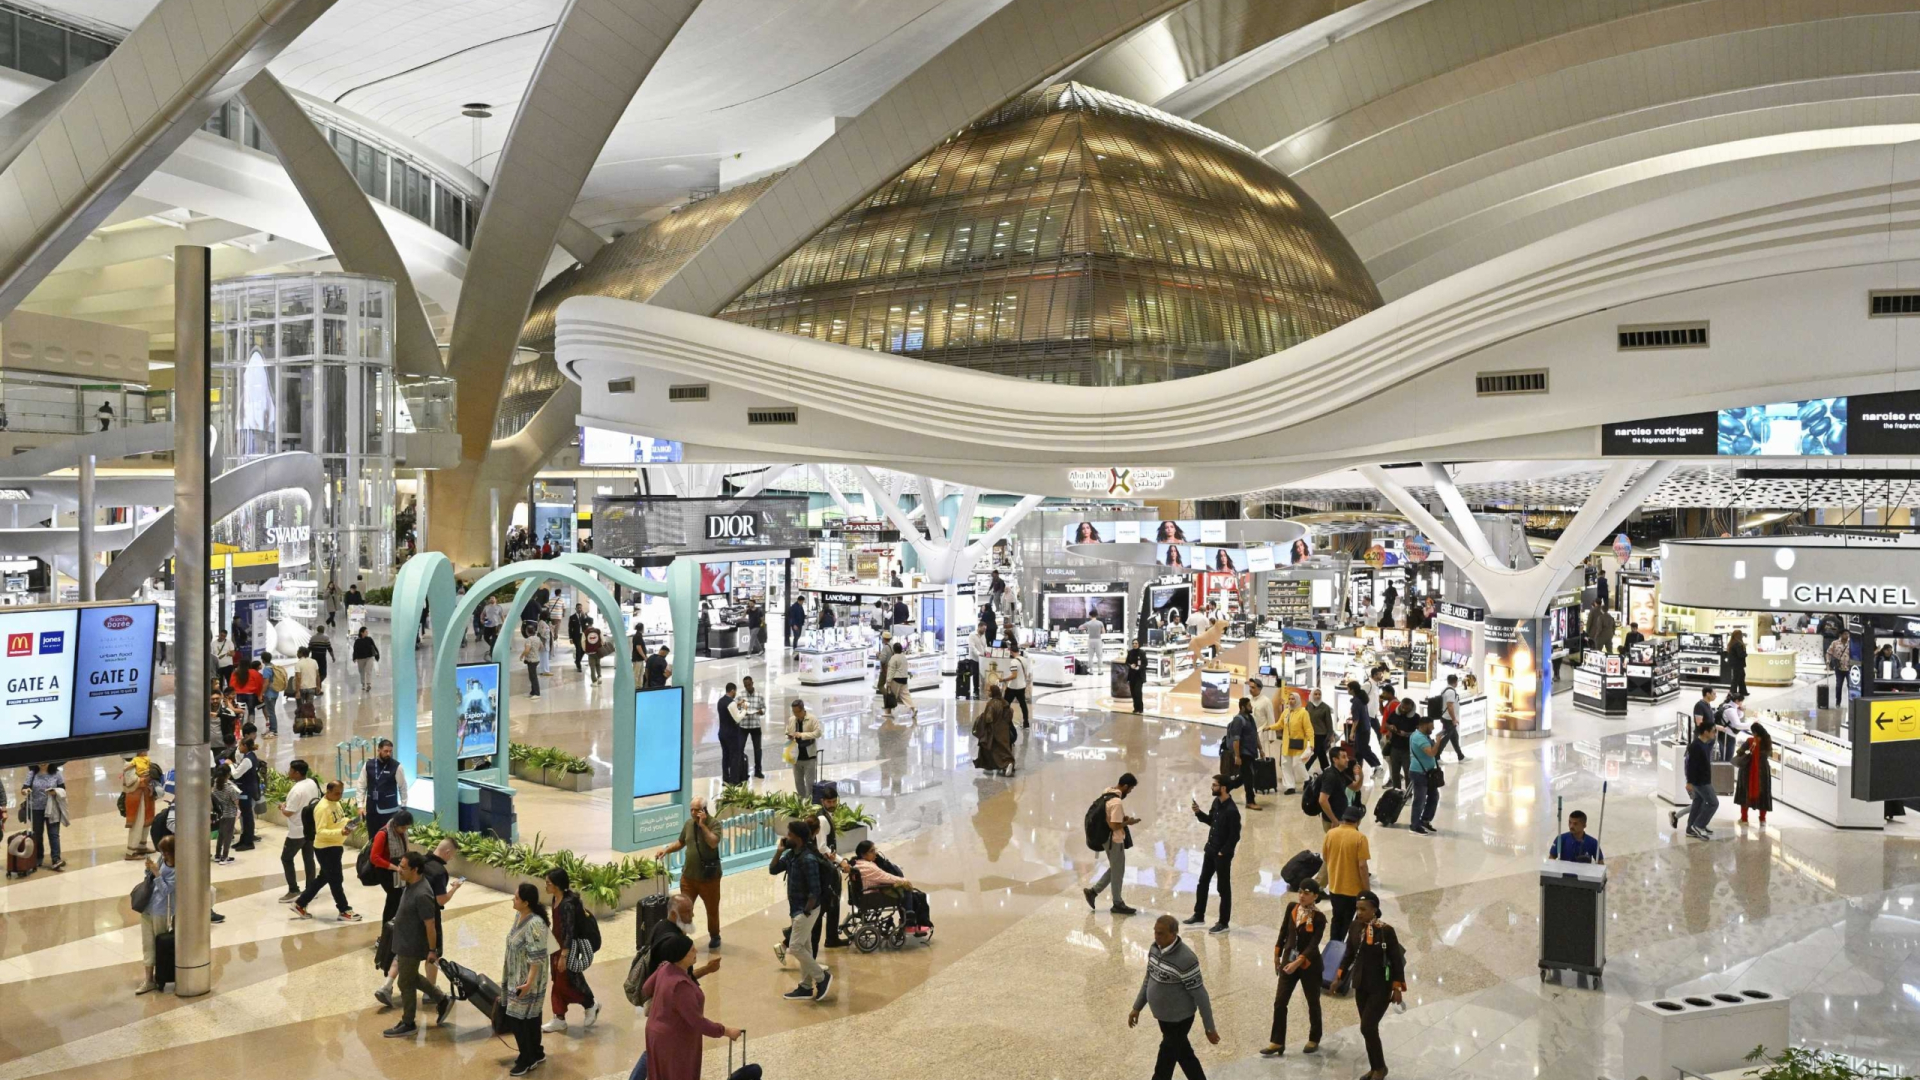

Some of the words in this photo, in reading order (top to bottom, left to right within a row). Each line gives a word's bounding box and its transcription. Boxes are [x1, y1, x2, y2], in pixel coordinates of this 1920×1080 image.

[1861, 411, 1906, 421] narciso
[1614, 427, 1652, 436] narciso
[1654, 426, 1705, 436] rodriguez
[709, 515, 755, 538] DIOR
[264, 553, 270, 561] A
[610, 558, 635, 566] DIOR
[1046, 568, 1076, 576] GUERLAIN
[1065, 584, 1085, 592] TOM
[1084, 584, 1108, 592] FORD
[1794, 586, 1916, 605] CHANEL
[1453, 606, 1468, 618] LAUDER
[43, 636, 61, 645] jones
[90, 669, 125, 685] GATE
[129, 668, 139, 681] D
[7, 676, 45, 693] GATE
[49, 675, 59, 689] A
[464, 712, 486, 720] Explore
[640, 825, 651, 833] Find
[652, 823, 666, 832] your
[666, 821, 679, 829] pace
